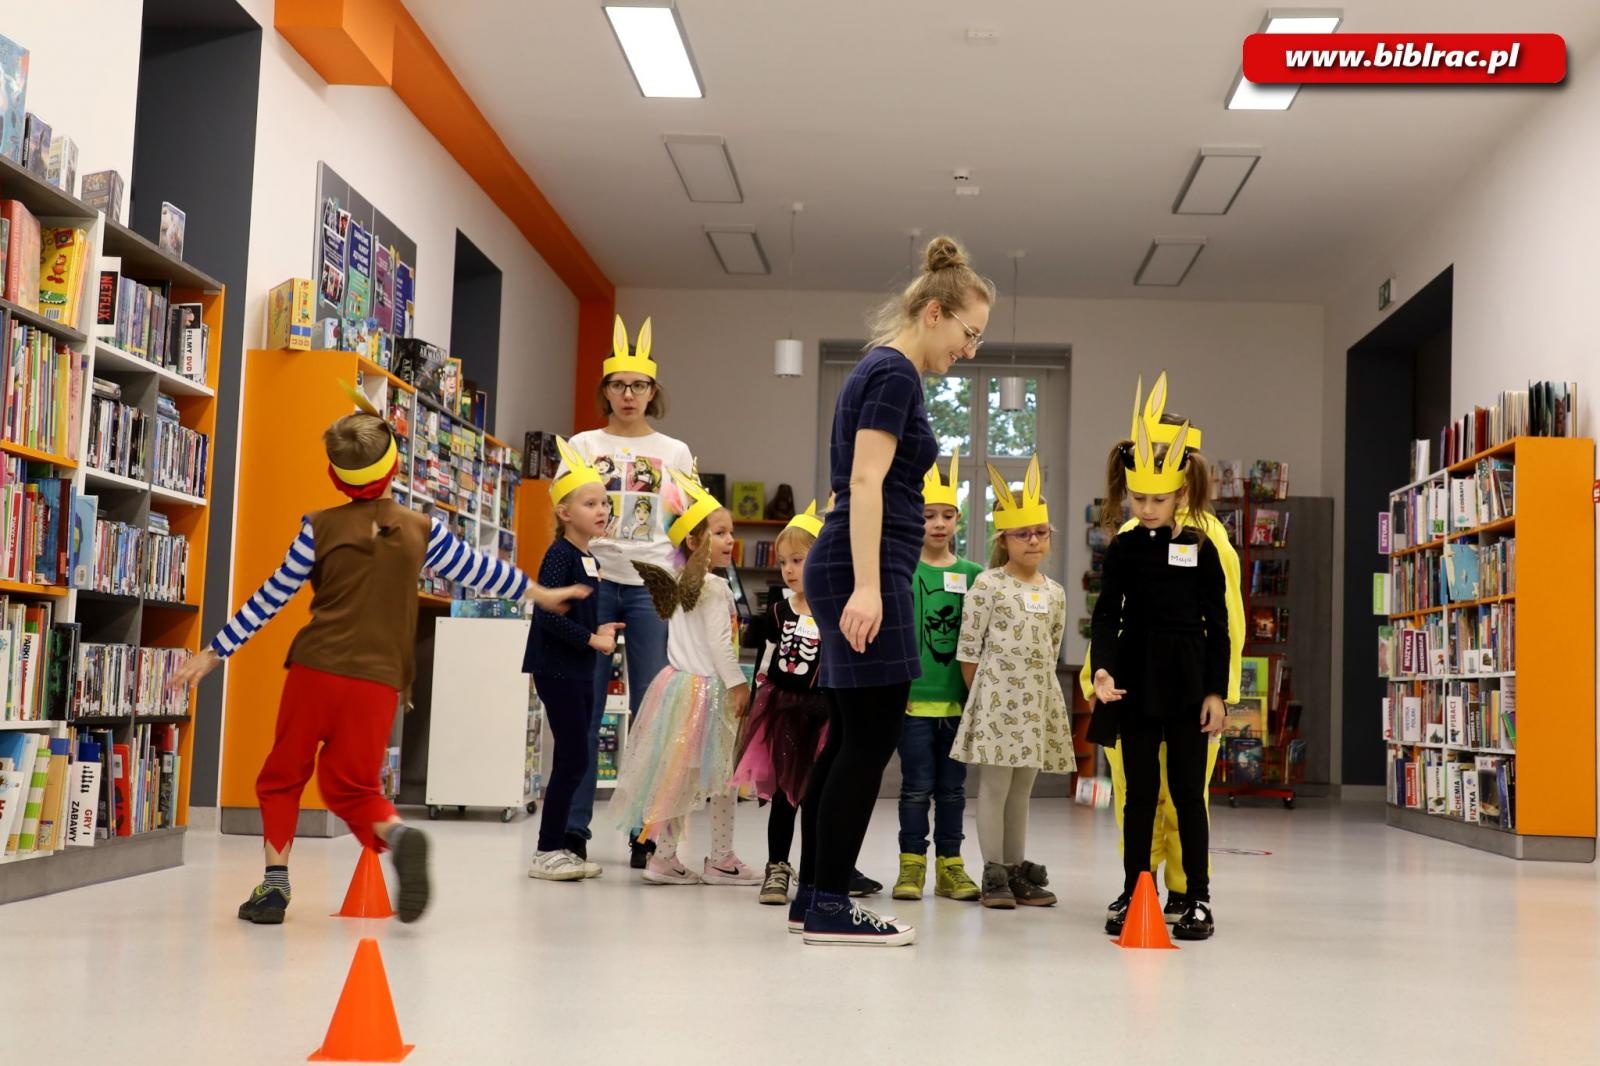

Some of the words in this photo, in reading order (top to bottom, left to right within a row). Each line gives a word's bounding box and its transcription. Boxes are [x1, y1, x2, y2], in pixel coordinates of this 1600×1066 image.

[97, 274, 113, 320] NETFLIX
[23, 634, 31, 659] PARKI
[1404, 635, 1412, 667] MUZYKA
[1454, 780, 1462, 810] CHEMIA
[1469, 791, 1477, 821] FIZYKA
[68, 801, 80, 842] ZABAWY
[83, 809, 93, 829] GRY
